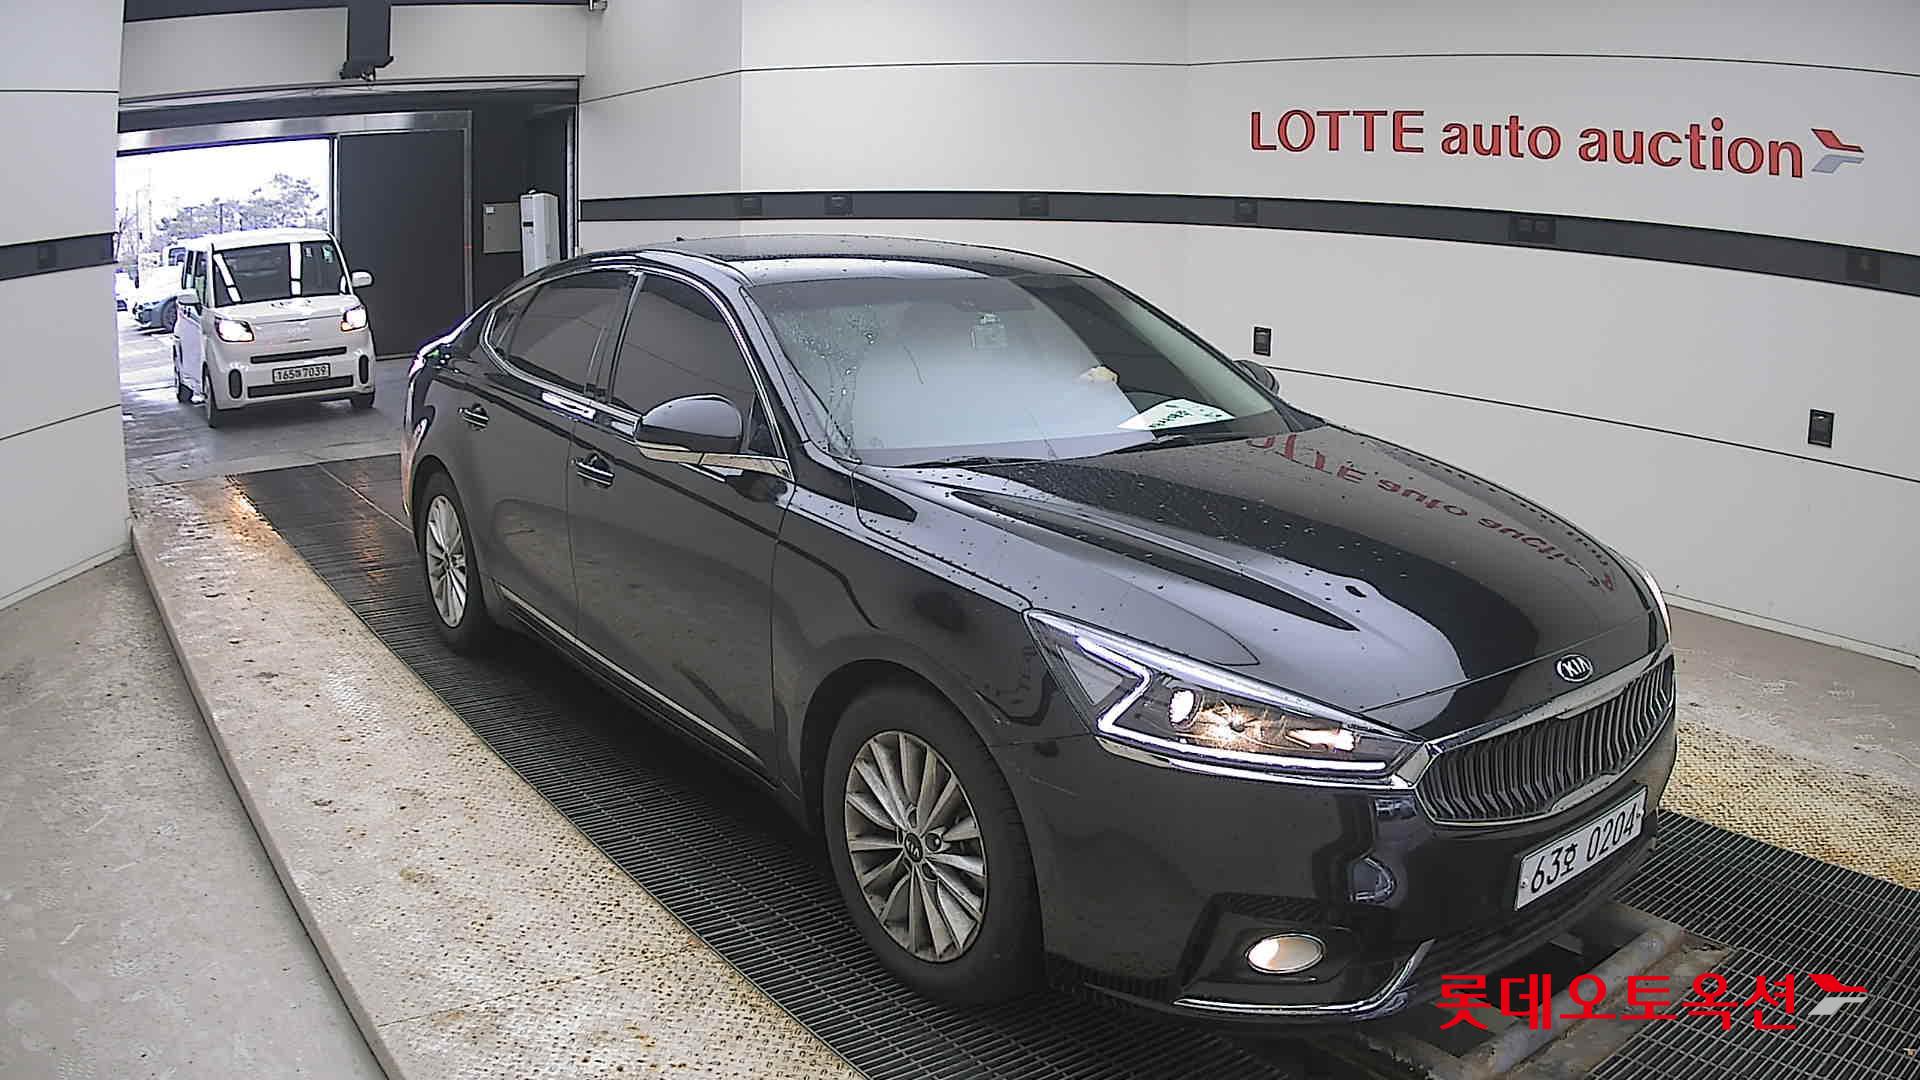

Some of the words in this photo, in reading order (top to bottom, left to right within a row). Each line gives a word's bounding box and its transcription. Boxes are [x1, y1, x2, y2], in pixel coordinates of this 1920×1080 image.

[1250, 109, 1425, 154] LOTTE
[1441, 114, 1562, 161] auto
[1577, 116, 1804, 179] auction
[1561, 657, 1590, 678] KIA
[1531, 843, 1578, 894] 63호
[1586, 803, 1637, 862] 0204
